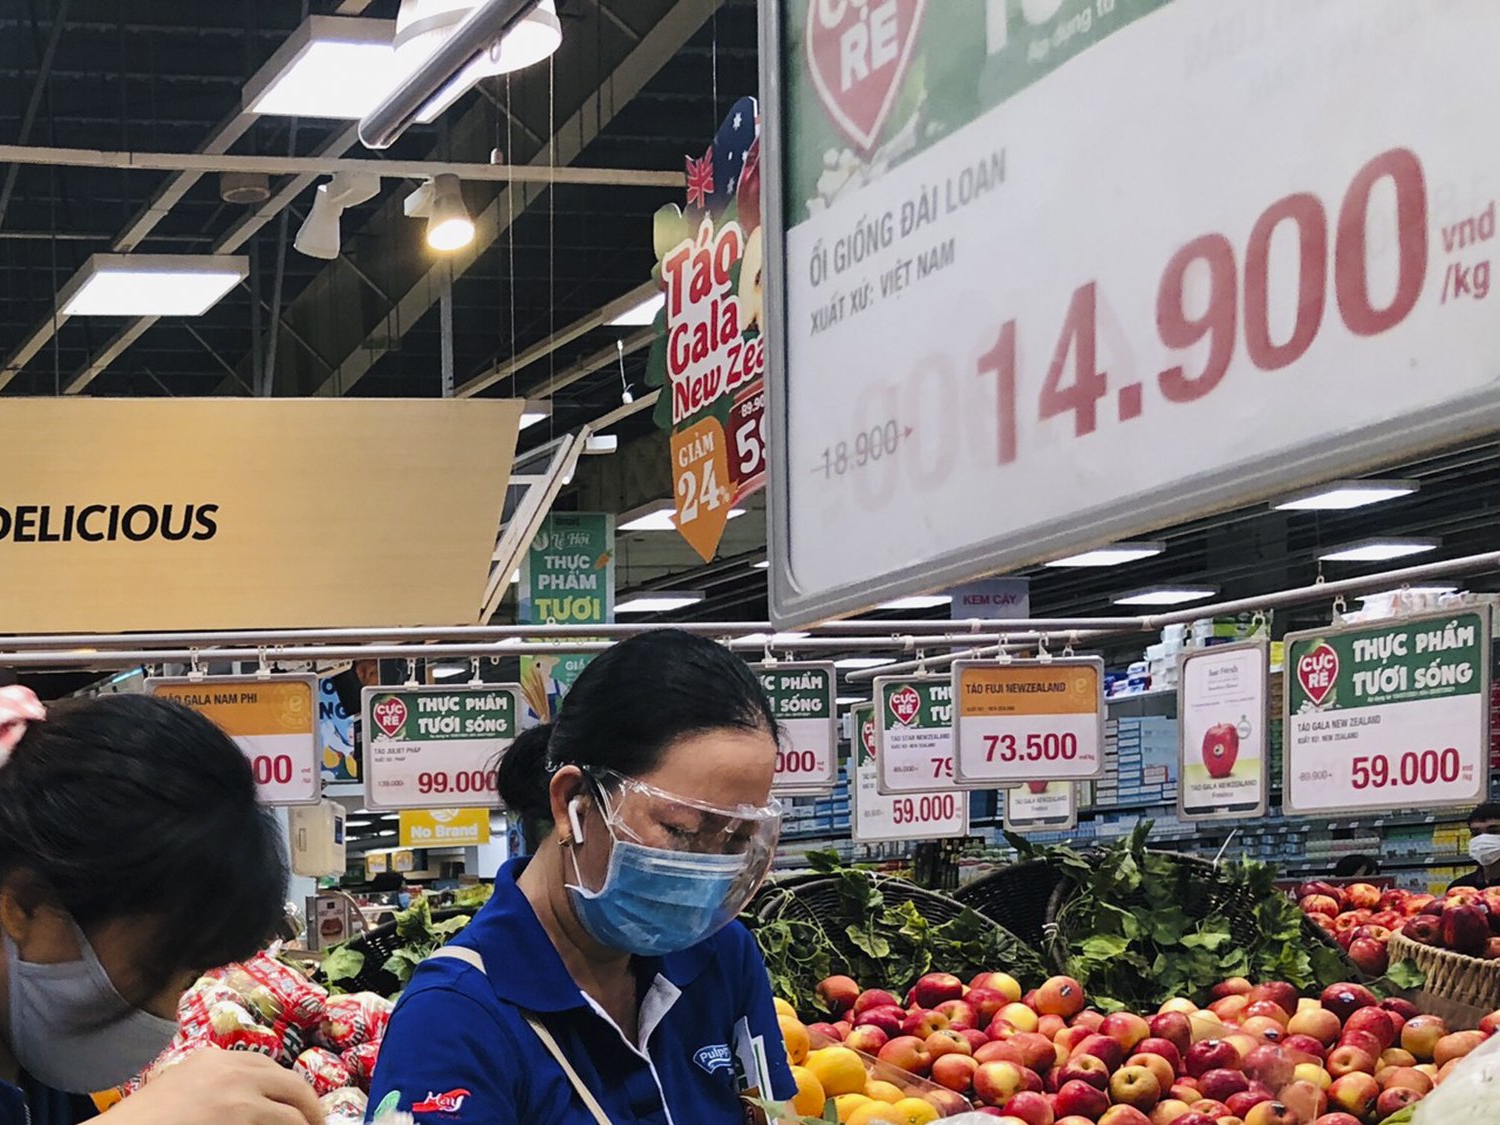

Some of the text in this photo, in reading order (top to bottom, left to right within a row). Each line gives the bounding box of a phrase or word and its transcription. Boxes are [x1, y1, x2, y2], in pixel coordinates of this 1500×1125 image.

[834, 212, 893, 274] GIỐNG
[946, 148, 1007, 214] LOAN
[1441, 200, 1495, 253] vnd
[666, 228, 739, 317] Táo
[917, 238, 955, 280] NAM
[1441, 260, 1490, 305] /kg
[976, 146, 1429, 467] 14.900
[669, 297, 740, 377] Gala
[674, 365, 722, 421] New
[679, 431, 714, 468] GIẢM
[544, 555, 591, 574] THỰC
[538, 569, 597, 590] PHẨM
[534, 598, 600, 620] TƯƠI
[963, 594, 990, 605] KEM
[1352, 620, 1475, 664] THỰC PHẨM
[1301, 653, 1335, 672] CỰC
[781, 671, 823, 691] PHẨM
[965, 682, 1066, 694] TÁO FUJI NEWZEALAND
[1352, 665, 1408, 697] TƯƠI
[1414, 657, 1474, 689] SỐNG
[184, 694, 211, 706] GALA
[213, 692, 238, 705] NAM
[240, 692, 257, 704] PHI
[417, 692, 507, 715] THỰC PHẨM
[780, 693, 823, 713] SỐNG
[418, 713, 507, 734] TƯƠI SỐNG
[1311, 720, 1331, 731] GALA
[1332, 719, 1348, 728] NEW
[1349, 714, 1381, 727] ZEALAND
[982, 732, 1077, 762] 73.500
[418, 770, 499, 794] 99.000
[1352, 747, 1460, 790] 59.000
[892, 794, 954, 825] 59.000
[410, 823, 479, 838] No Brand
